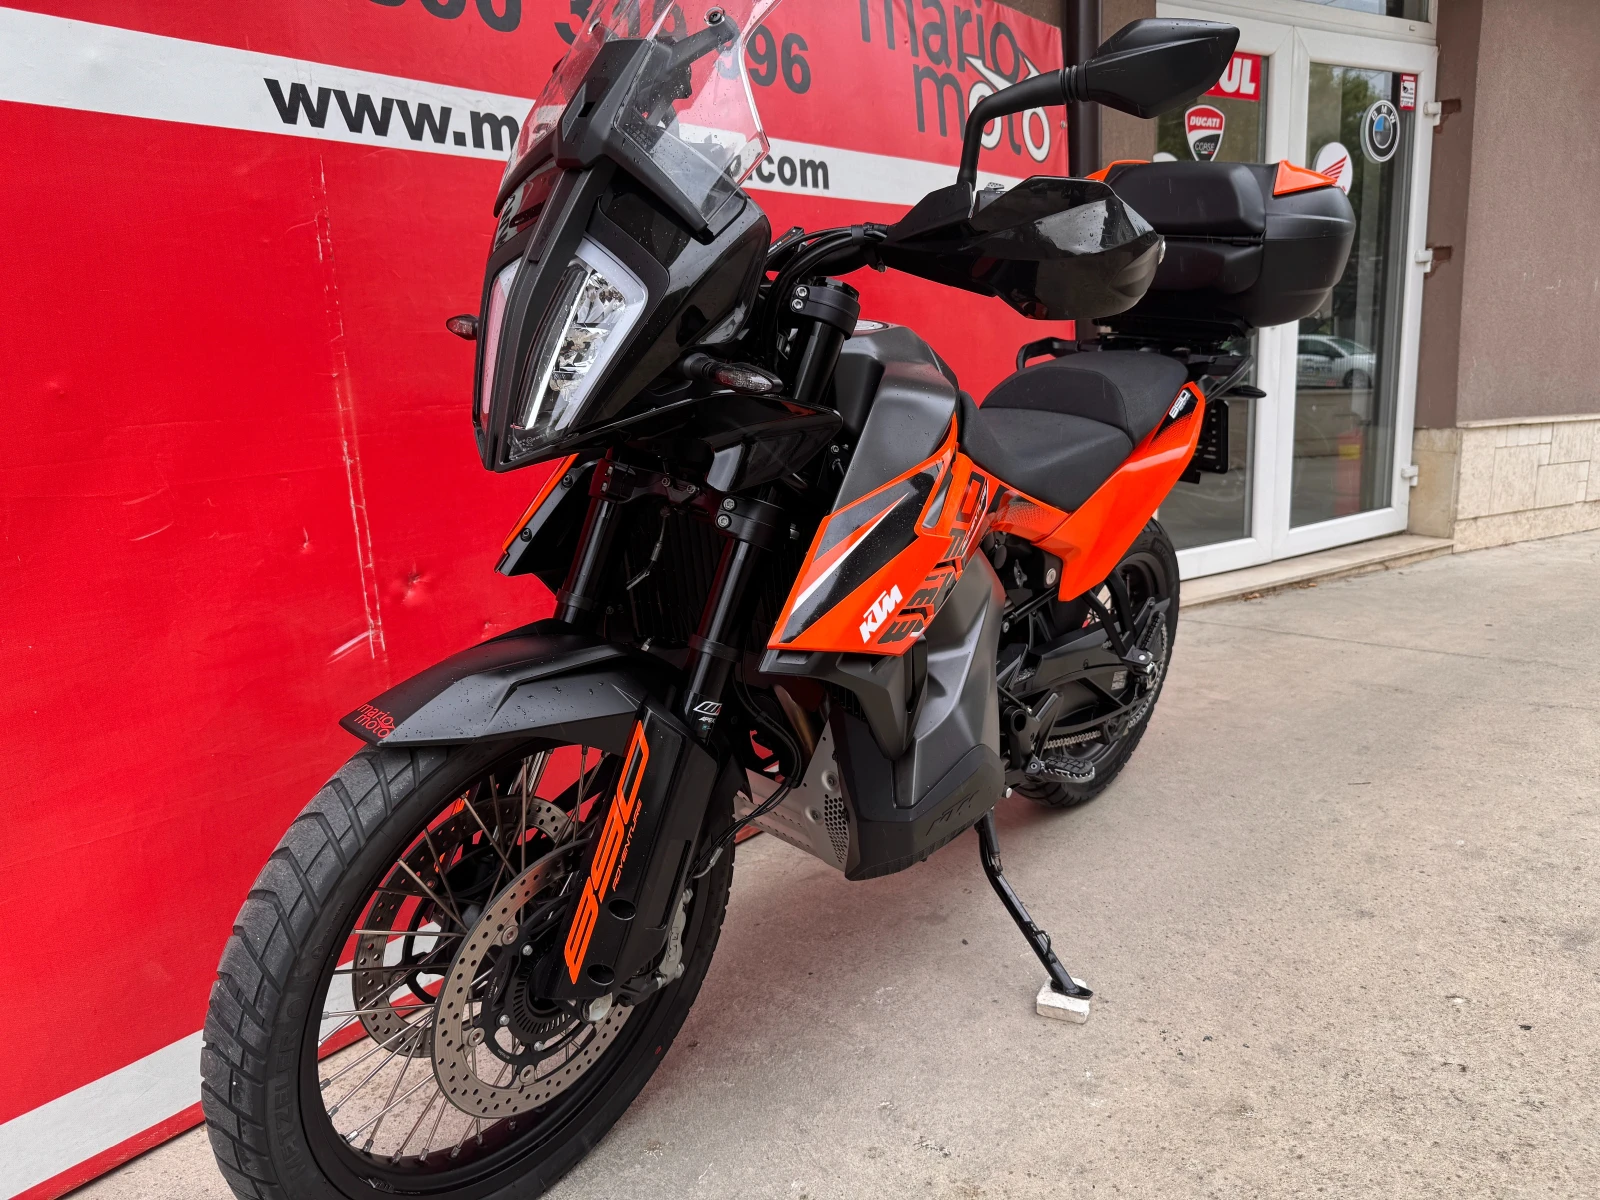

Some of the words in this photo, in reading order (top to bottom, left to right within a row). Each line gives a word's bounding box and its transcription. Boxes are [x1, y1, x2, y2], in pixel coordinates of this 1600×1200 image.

[859, 0, 1020, 86] mario
[1211, 57, 1256, 95] UL
[1189, 116, 1220, 129] DUCATI
[1371, 105, 1396, 124] BMW
[858, 584, 903, 644] KTM
[353, 714, 391, 739] moto
[357, 703, 394, 726] mario
[564, 720, 649, 985] 890
[611, 798, 642, 892] ADVENTURE
